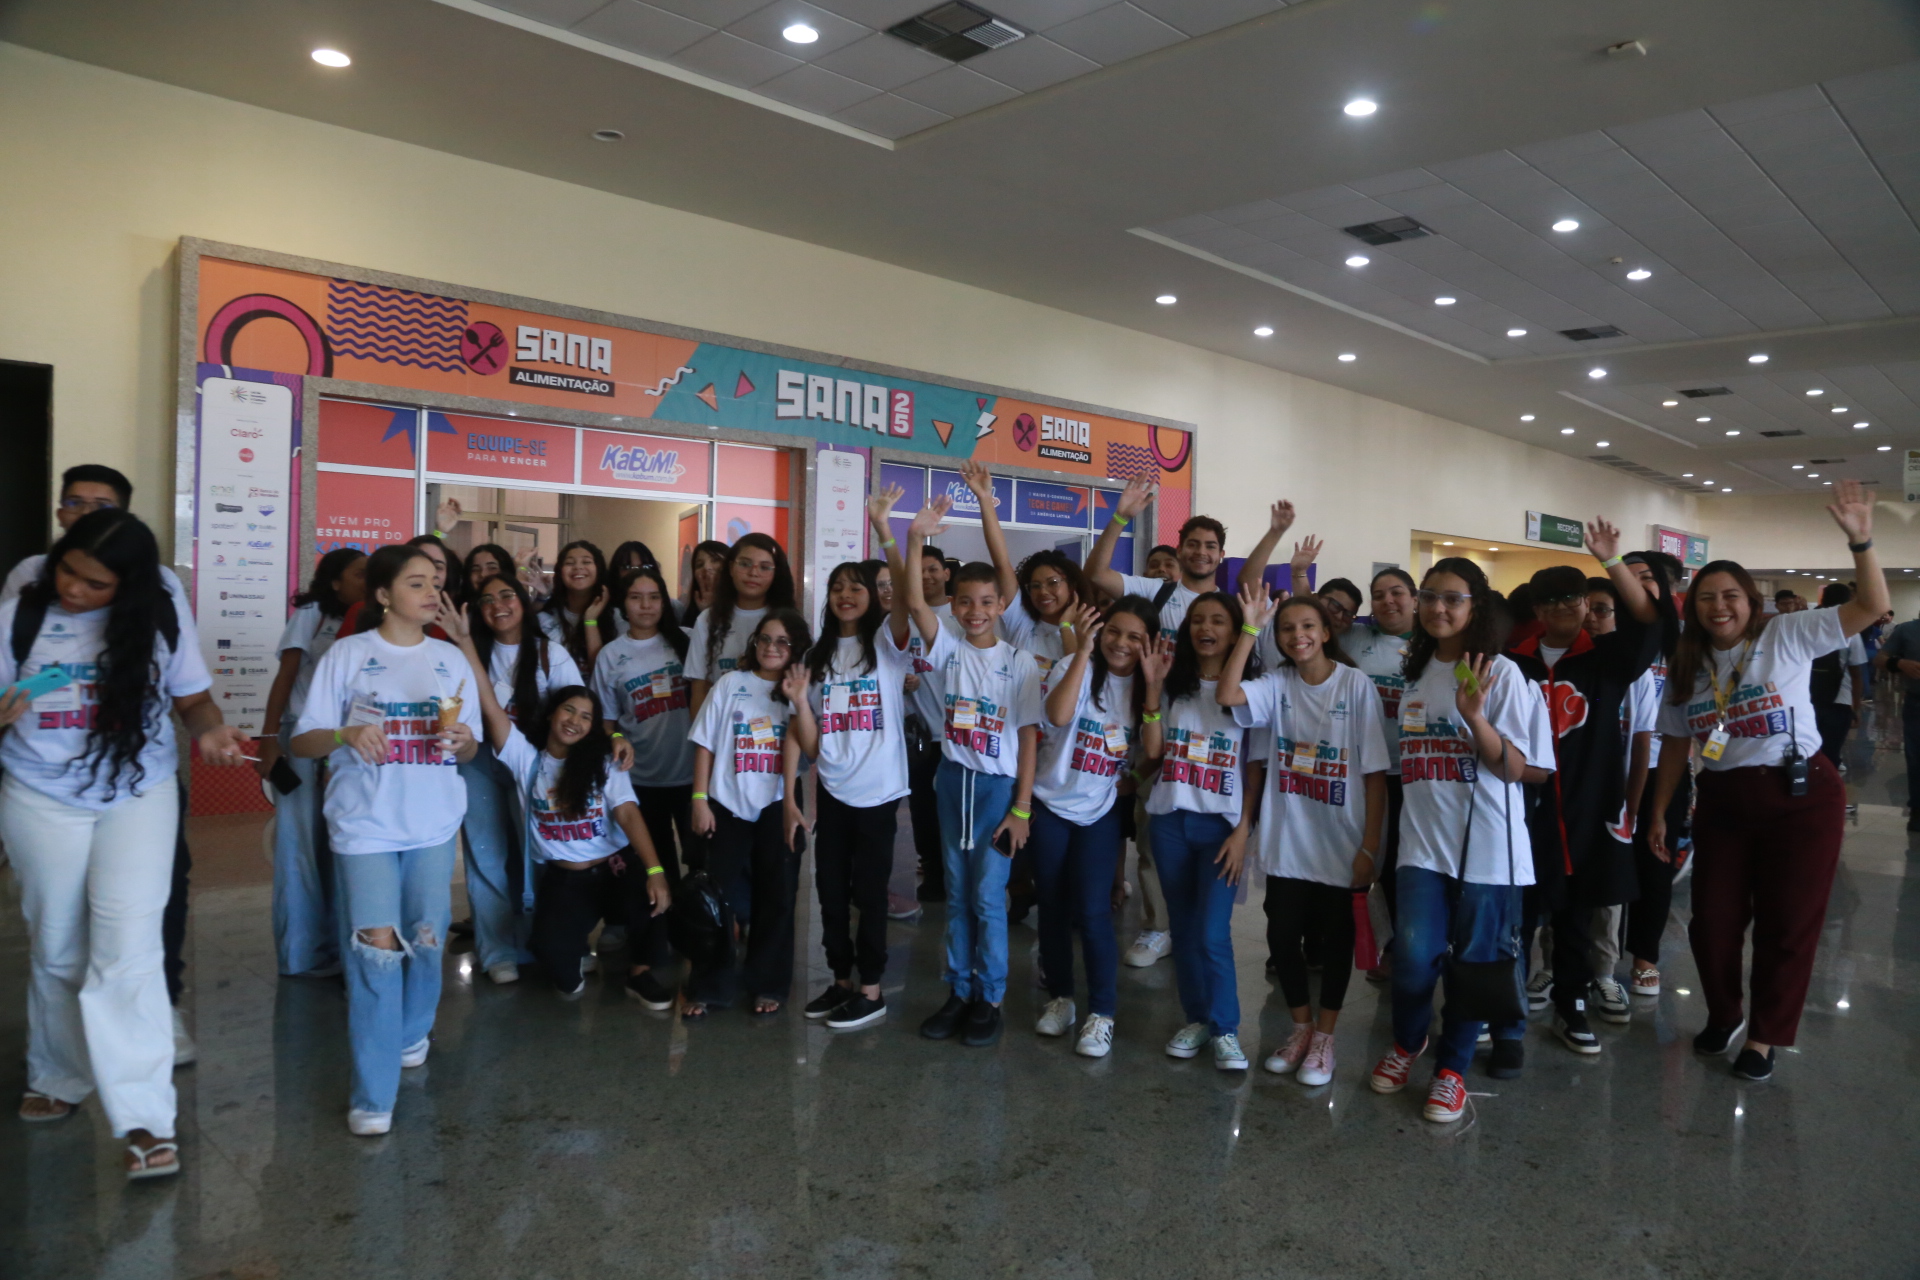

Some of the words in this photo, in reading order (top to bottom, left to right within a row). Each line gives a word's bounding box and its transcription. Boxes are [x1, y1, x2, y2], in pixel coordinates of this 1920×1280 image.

[516, 325, 612, 375] SANA
[516, 371, 609, 393] ALIMENTAÇÃO
[776, 369, 887, 435] SANA
[893, 392, 910, 434] 25
[230, 428, 258, 439] Claro
[1041, 414, 1090, 448] SANA
[467, 433, 547, 457] EQUIPE-SE
[1041, 448, 1089, 462] ALIMENTAÇÃO
[467, 452, 497, 463] PARA
[502, 456, 547, 467] VENCER
[601, 445, 677, 474] KaBuM!
[316, 528, 379, 539] ESTANDE
[384, 531, 402, 540] DO
[329, 516, 358, 526] VEM
[364, 517, 391, 528] PRO
[1556, 522, 1580, 535] RECEPÇÃO
[821, 709, 873, 734] SANA
[1688, 694, 1783, 730] FORALEZA
[1771, 711, 1786, 732] 25
[377, 739, 443, 765] ANA
[1162, 759, 1222, 793] SANA
[1401, 755, 1463, 784] SANA
[1278, 769, 1329, 804] SANA
[538, 822, 592, 842] SANA
